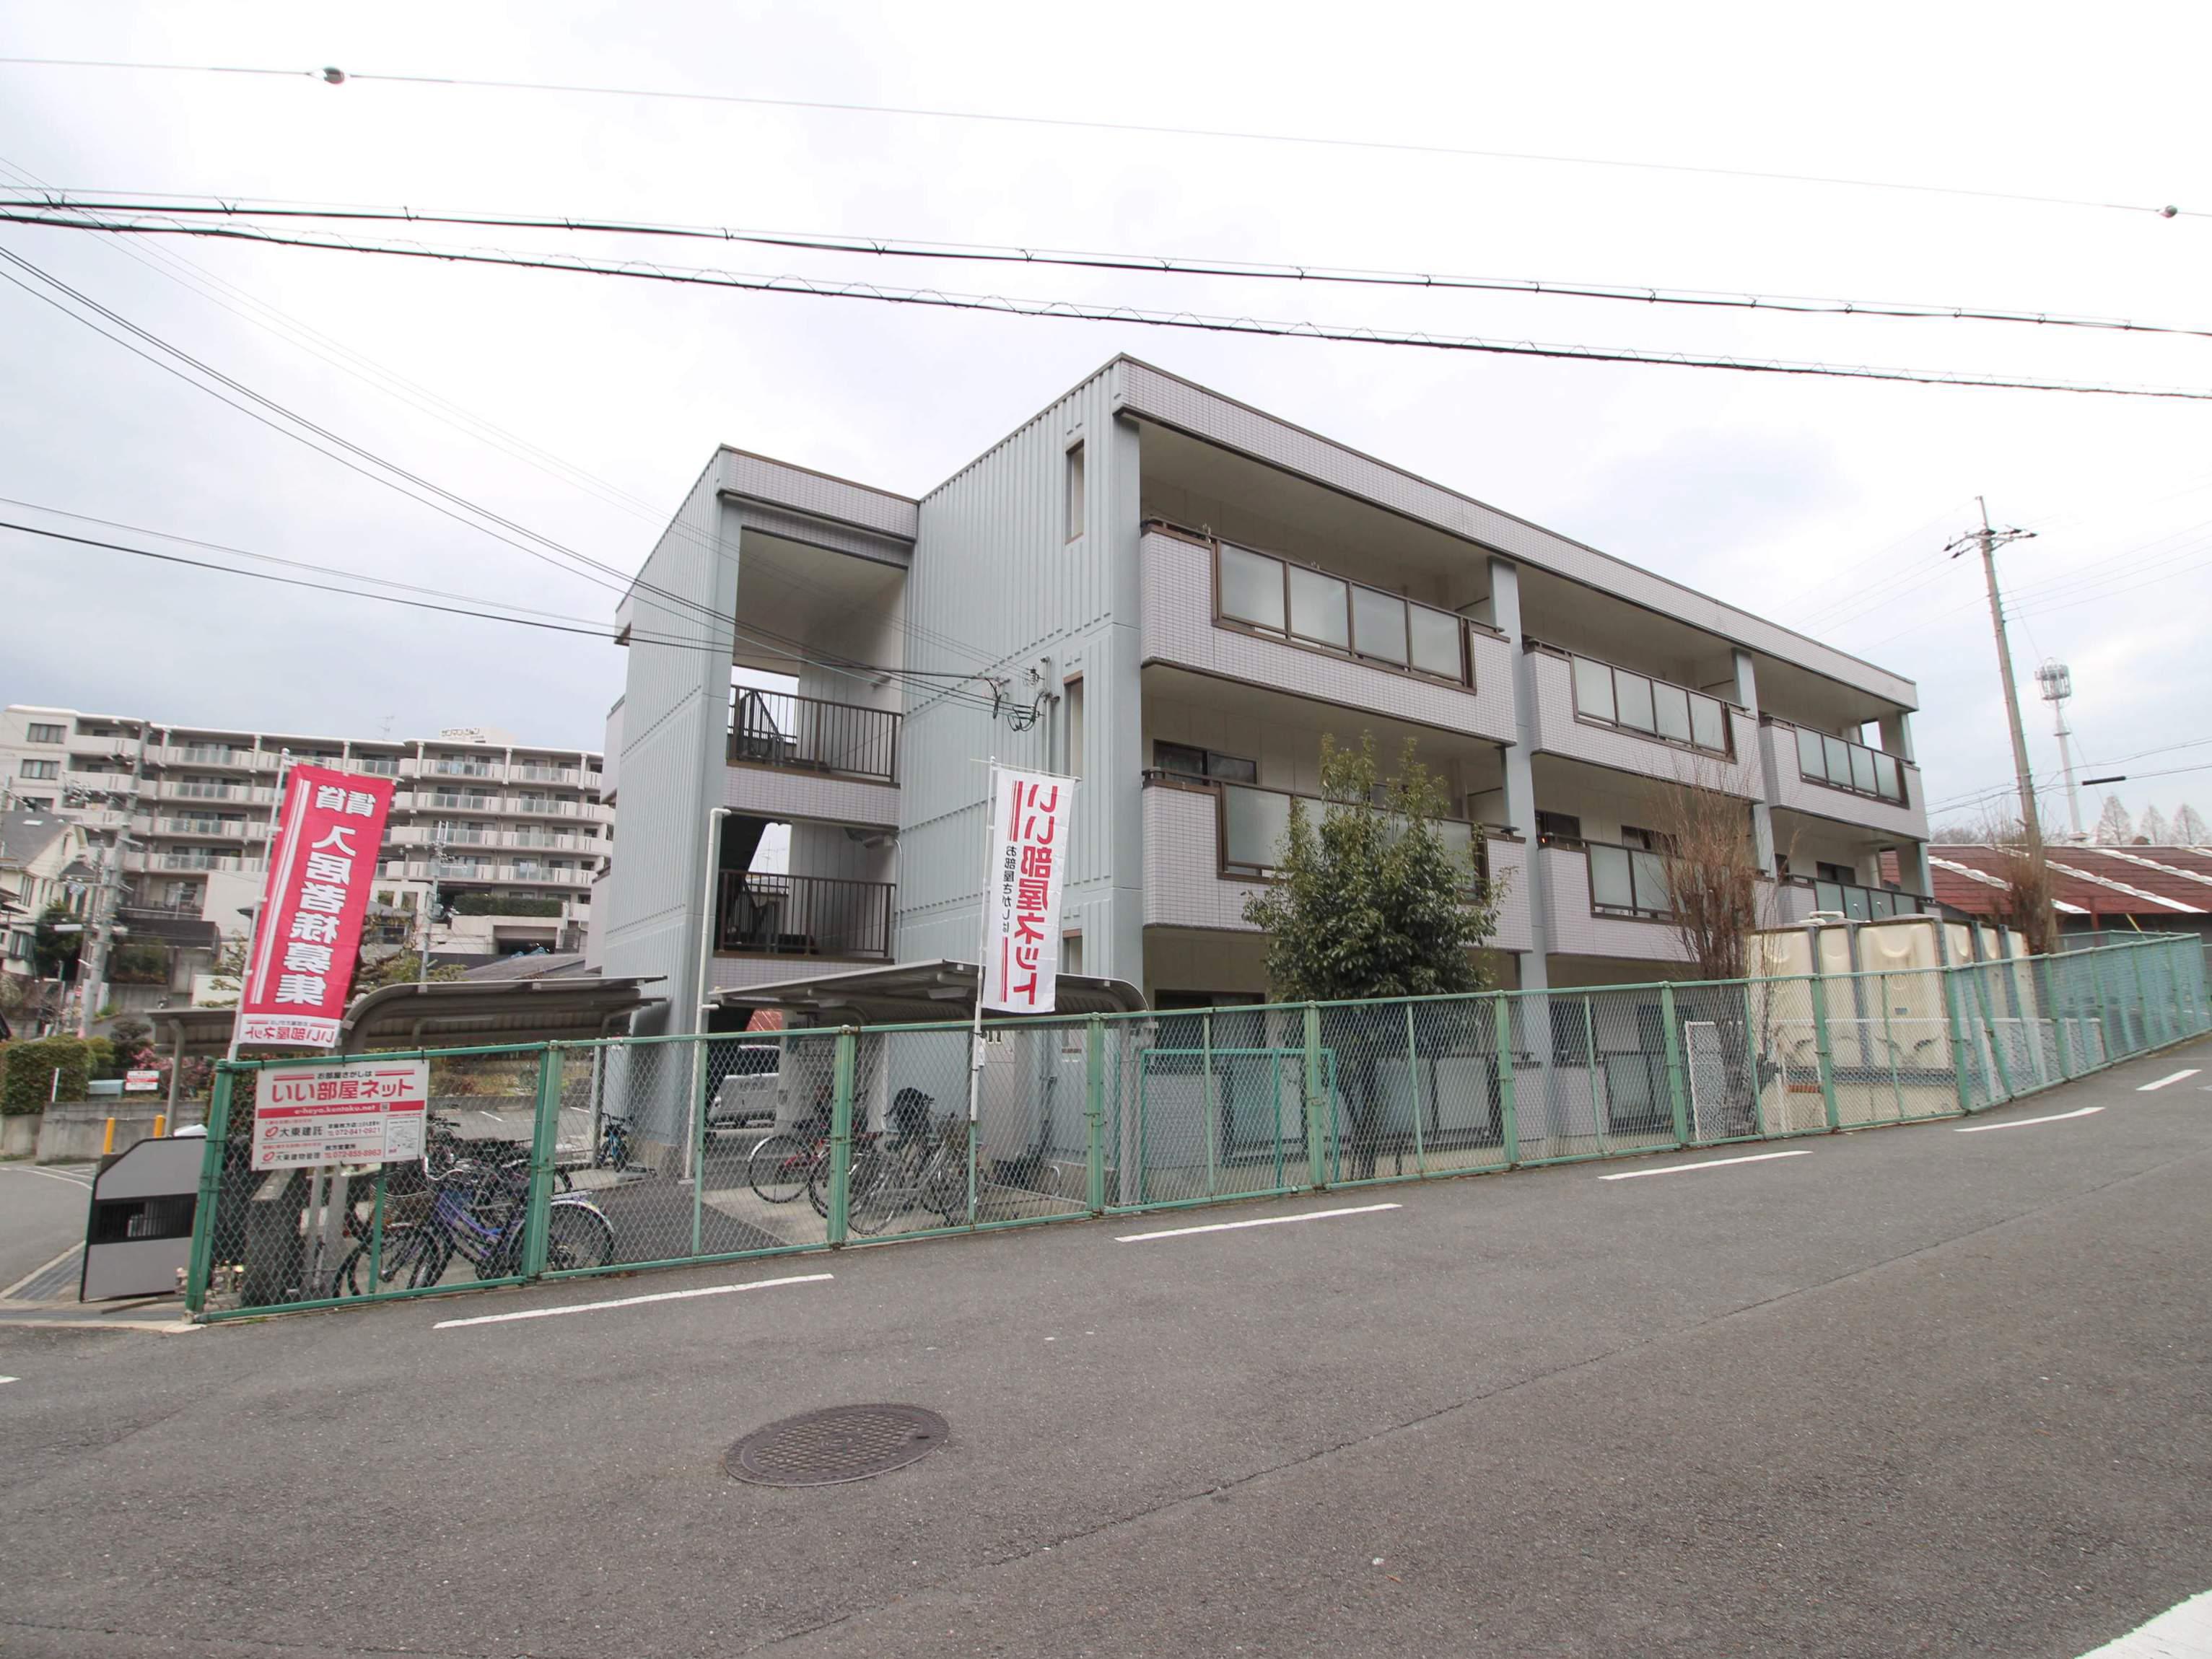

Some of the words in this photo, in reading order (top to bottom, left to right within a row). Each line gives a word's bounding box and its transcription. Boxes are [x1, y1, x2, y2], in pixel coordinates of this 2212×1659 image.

[317, 1070, 372, 1080] お部屋さがしは
[271, 1078, 414, 1103] いい部屋ネット
[279, 1126, 323, 1138] 大東建託
